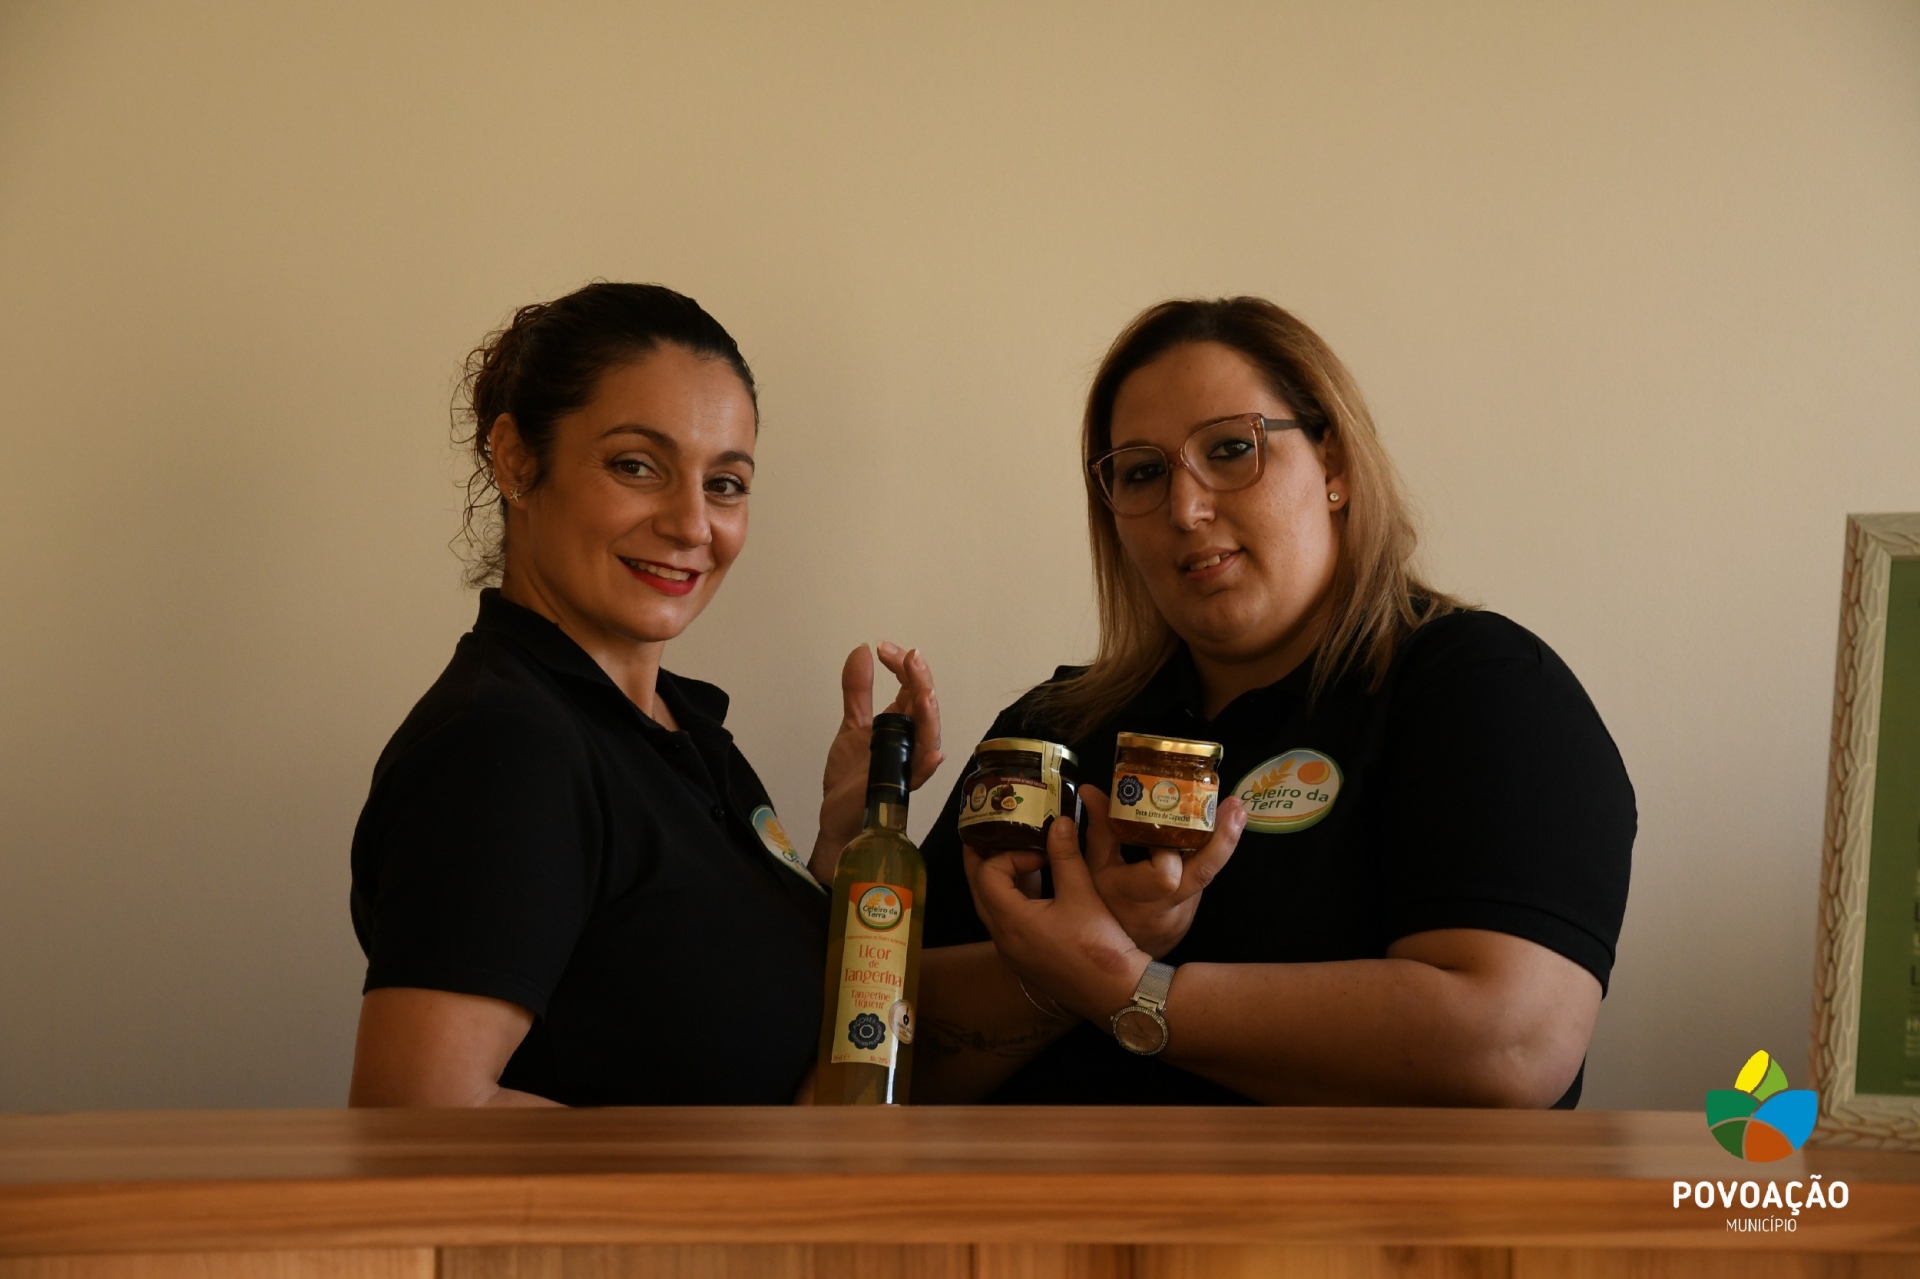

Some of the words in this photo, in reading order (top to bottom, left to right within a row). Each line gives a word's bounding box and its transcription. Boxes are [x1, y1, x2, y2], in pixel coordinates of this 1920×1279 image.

[1241, 786, 1302, 801] Celeiro
[1306, 788, 1330, 803] da
[1250, 799, 1294, 811] Terra
[862, 904, 888, 913] Celeiro
[889, 908, 898, 916] da
[858, 944, 892, 961] Licor
[869, 960, 880, 968] de
[844, 968, 903, 988] Tangerina
[851, 990, 892, 1002] Tangerine
[854, 999, 885, 1010] Liqueur
